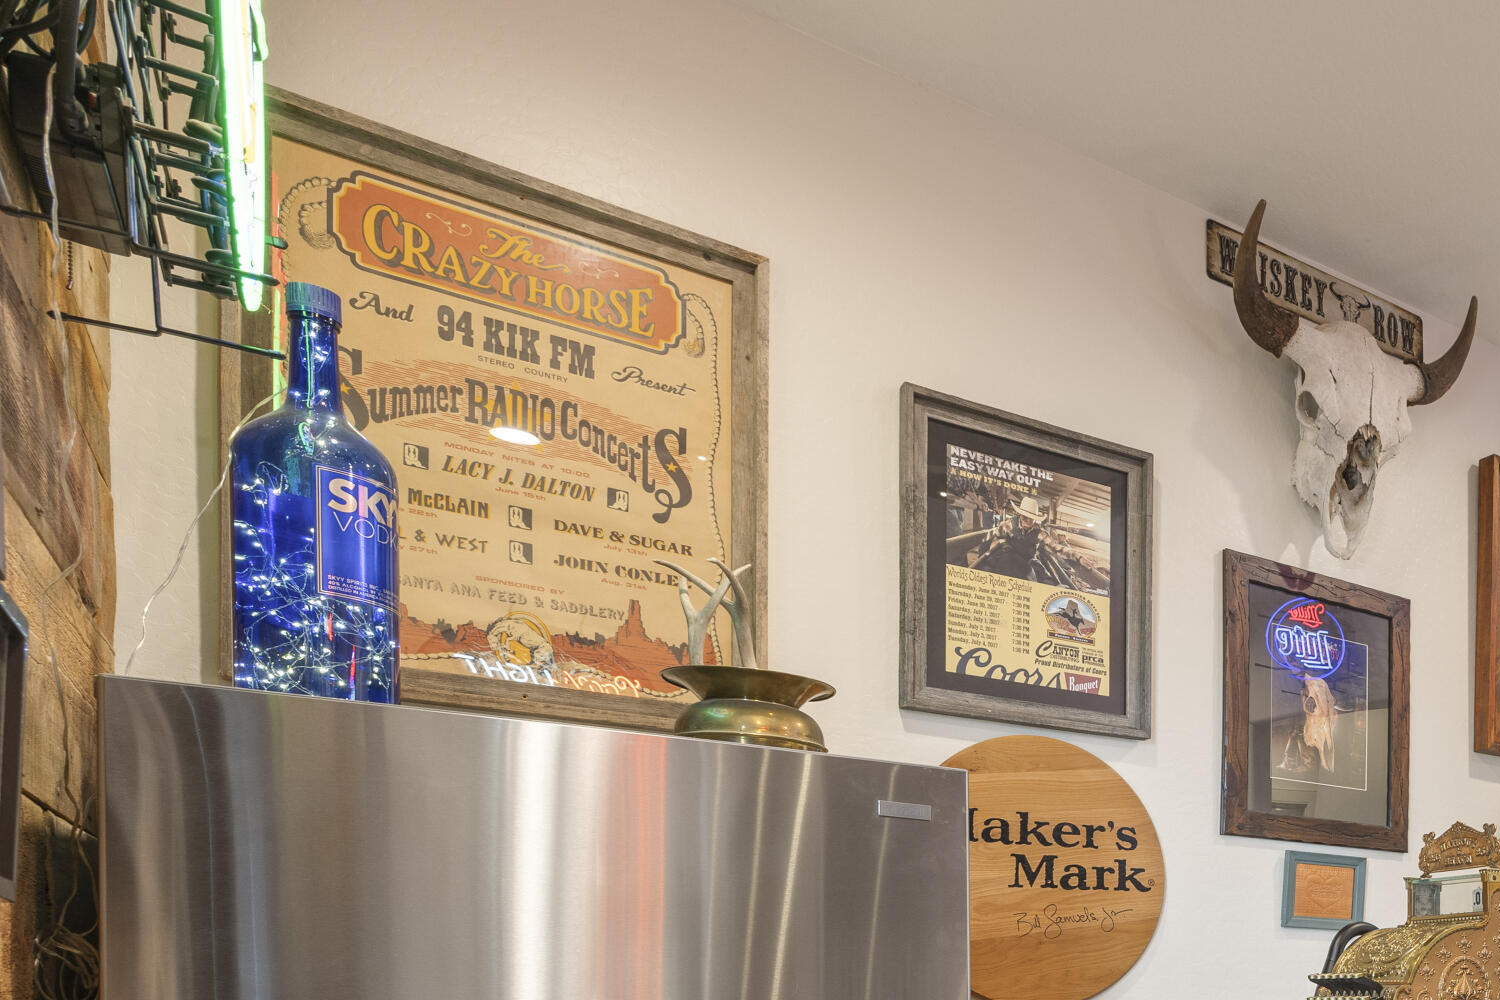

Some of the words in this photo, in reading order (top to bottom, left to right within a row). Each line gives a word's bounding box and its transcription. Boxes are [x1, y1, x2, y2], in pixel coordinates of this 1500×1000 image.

[479, 228, 570, 274] The
[362, 204, 520, 297] CRAZY
[526, 275, 657, 341] HORSE
[350, 291, 414, 323] And
[1217, 232, 1327, 318] WISKEY
[1373, 304, 1416, 355] ROW
[437, 305, 474, 347] 94
[483, 316, 540, 365] KIK
[551, 334, 595, 379] FM
[478, 354, 515, 370] STEREO
[525, 367, 568, 383] COUNTRY
[611, 366, 695, 397] Present
[464, 377, 556, 441] RADIO
[444, 441, 495, 457] MONDAY
[502, 454, 535, 466] NITES
[541, 463, 554, 471] AT
[951, 446, 993, 465] NEVER
[995, 457, 1027, 474] TAKE
[1030, 466, 1054, 481] THE
[951, 457, 984, 472] EASY
[986, 466, 1015, 480] WAY
[1017, 474, 1041, 487] OUT
[442, 454, 496, 481] LACY
[499, 468, 514, 486] J.
[521, 472, 596, 502] DALTON
[495, 486, 519, 496] June
[960, 470, 981, 481] HOW
[984, 475, 1001, 486] IT'S
[1004, 481, 1030, 493] DONE
[408, 487, 490, 519] McCLAIN
[333, 512, 398, 552] VODK
[414, 529, 426, 543] &
[435, 532, 488, 553] WEST
[553, 519, 604, 540] DAVE
[608, 530, 625, 543] &
[629, 534, 693, 558] SUGAR
[475, 575, 545, 592] SPONSORED
[553, 554, 609, 574] JOHN
[614, 564, 692, 589] CONLE
[488, 589, 528, 606] FEED
[550, 599, 625, 621] SADDLERY
[1035, 640, 1080, 660] CANYON
[1035, 658, 1051, 667] Proud
[1082, 654, 1104, 664] prca
[1069, 676, 1098, 693] Banquet
[1008, 853, 1151, 892] Mark
